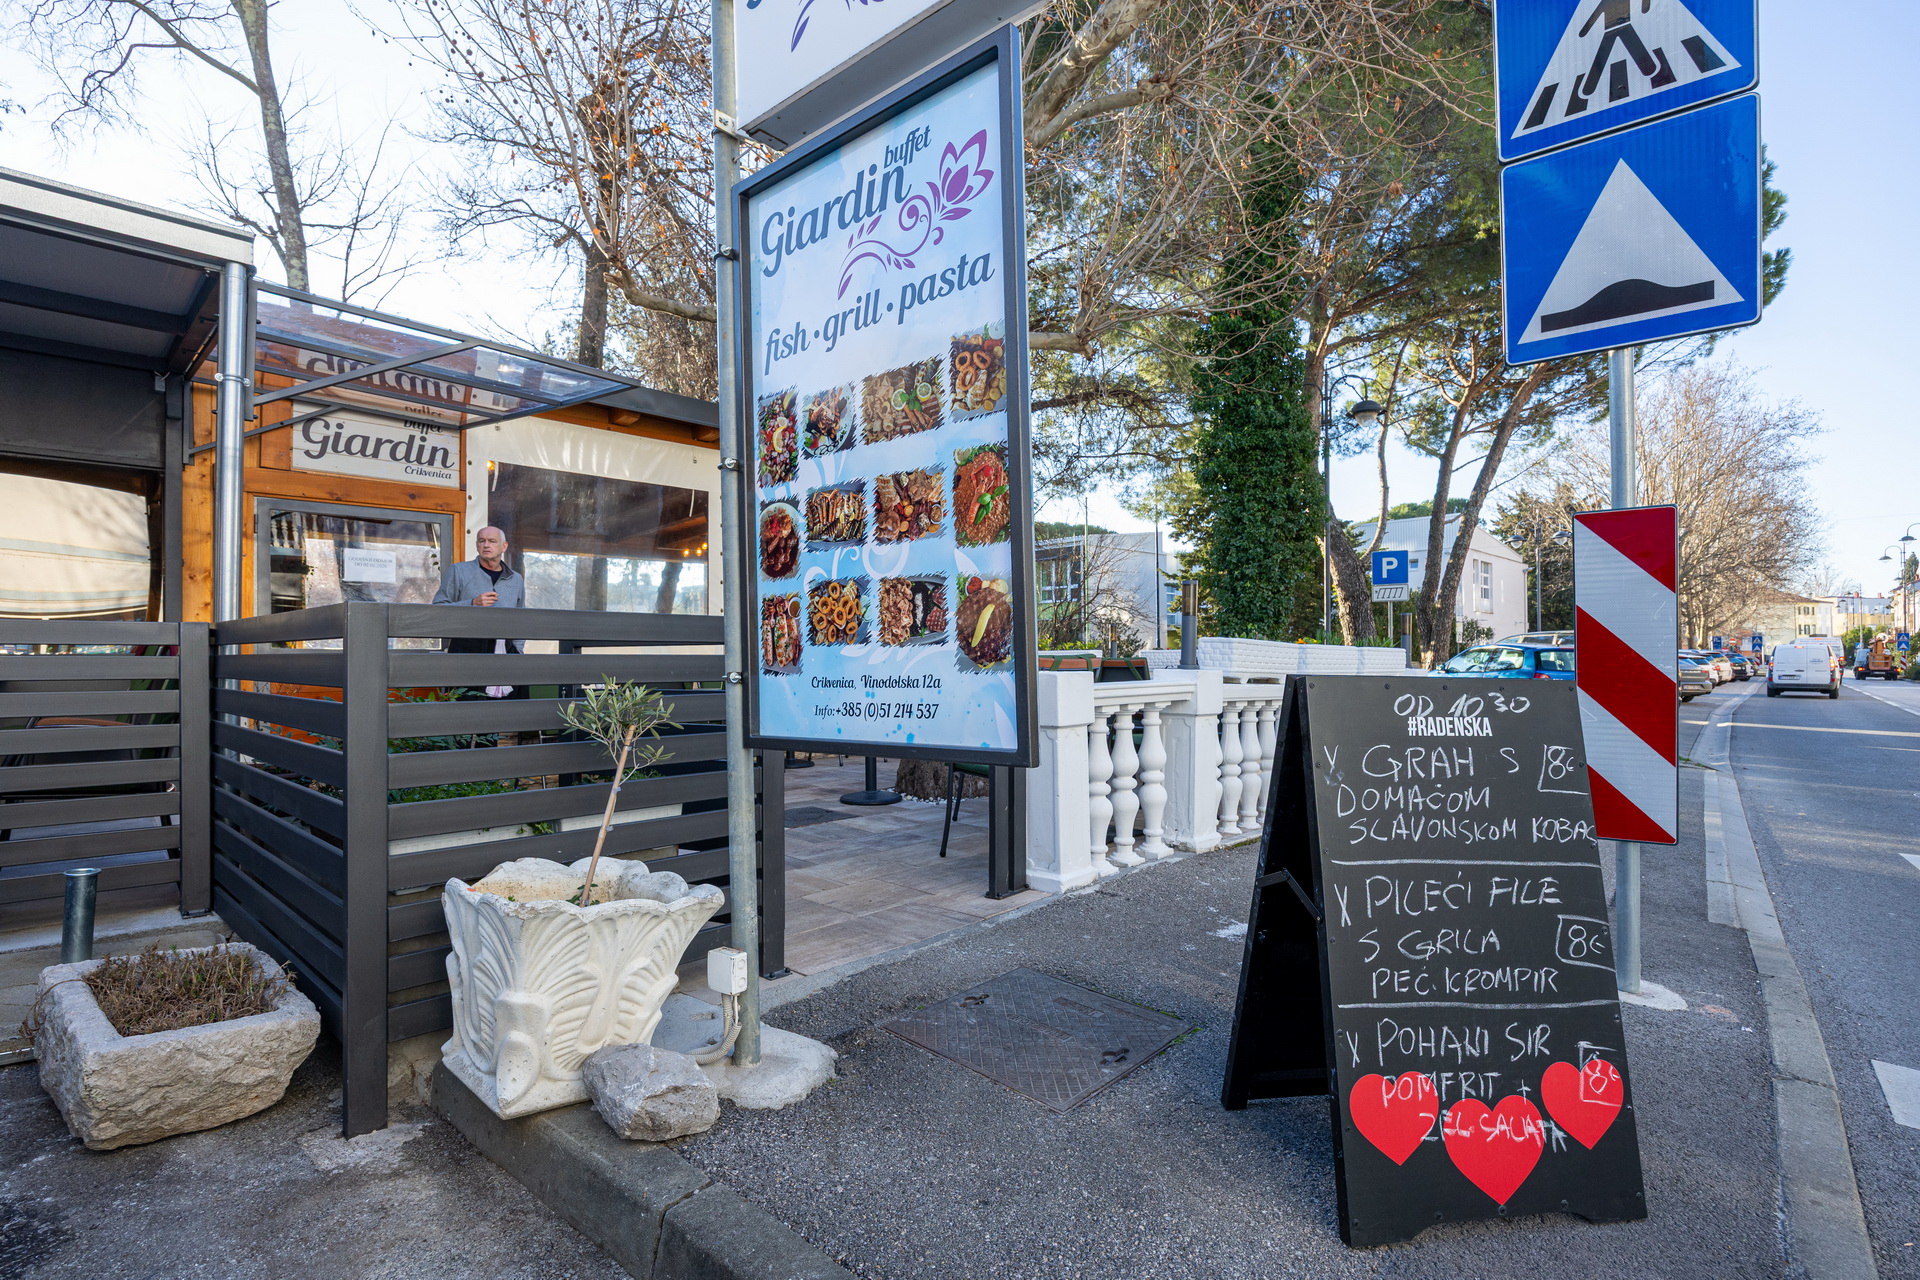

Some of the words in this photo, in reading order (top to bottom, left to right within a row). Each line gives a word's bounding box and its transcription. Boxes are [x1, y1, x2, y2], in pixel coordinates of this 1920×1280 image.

[884, 125, 931, 169] buffet
[761, 163, 913, 278] Giardin
[897, 252, 995, 325] pasta
[302, 417, 455, 469] Giardin
[404, 465, 452, 480] Crikvenica
[1382, 557, 1398, 578] P
[811, 676, 857, 690] Crikvenica,
[861, 674, 921, 689] Vinodolska
[922, 674, 942, 689] 12a
[864, 702, 891, 722] (0)51
[893, 703, 913, 719] 214
[915, 703, 939, 719] 537
[1393, 693, 1434, 718] OD
[1407, 716, 1493, 737] #RADENSKA
[1362, 744, 1475, 782] GRAH
[1499, 747, 1520, 774] S
[1489, 877, 1563, 908] FILE
[1358, 926, 1380, 963] S
[1397, 928, 1500, 960] GRILA
[1446, 967, 1560, 997] KROMPIR
[1377, 1017, 1489, 1067] POHANI
[1505, 1022, 1550, 1062] SIR
[1381, 1070, 1502, 1109] POMFRIT
